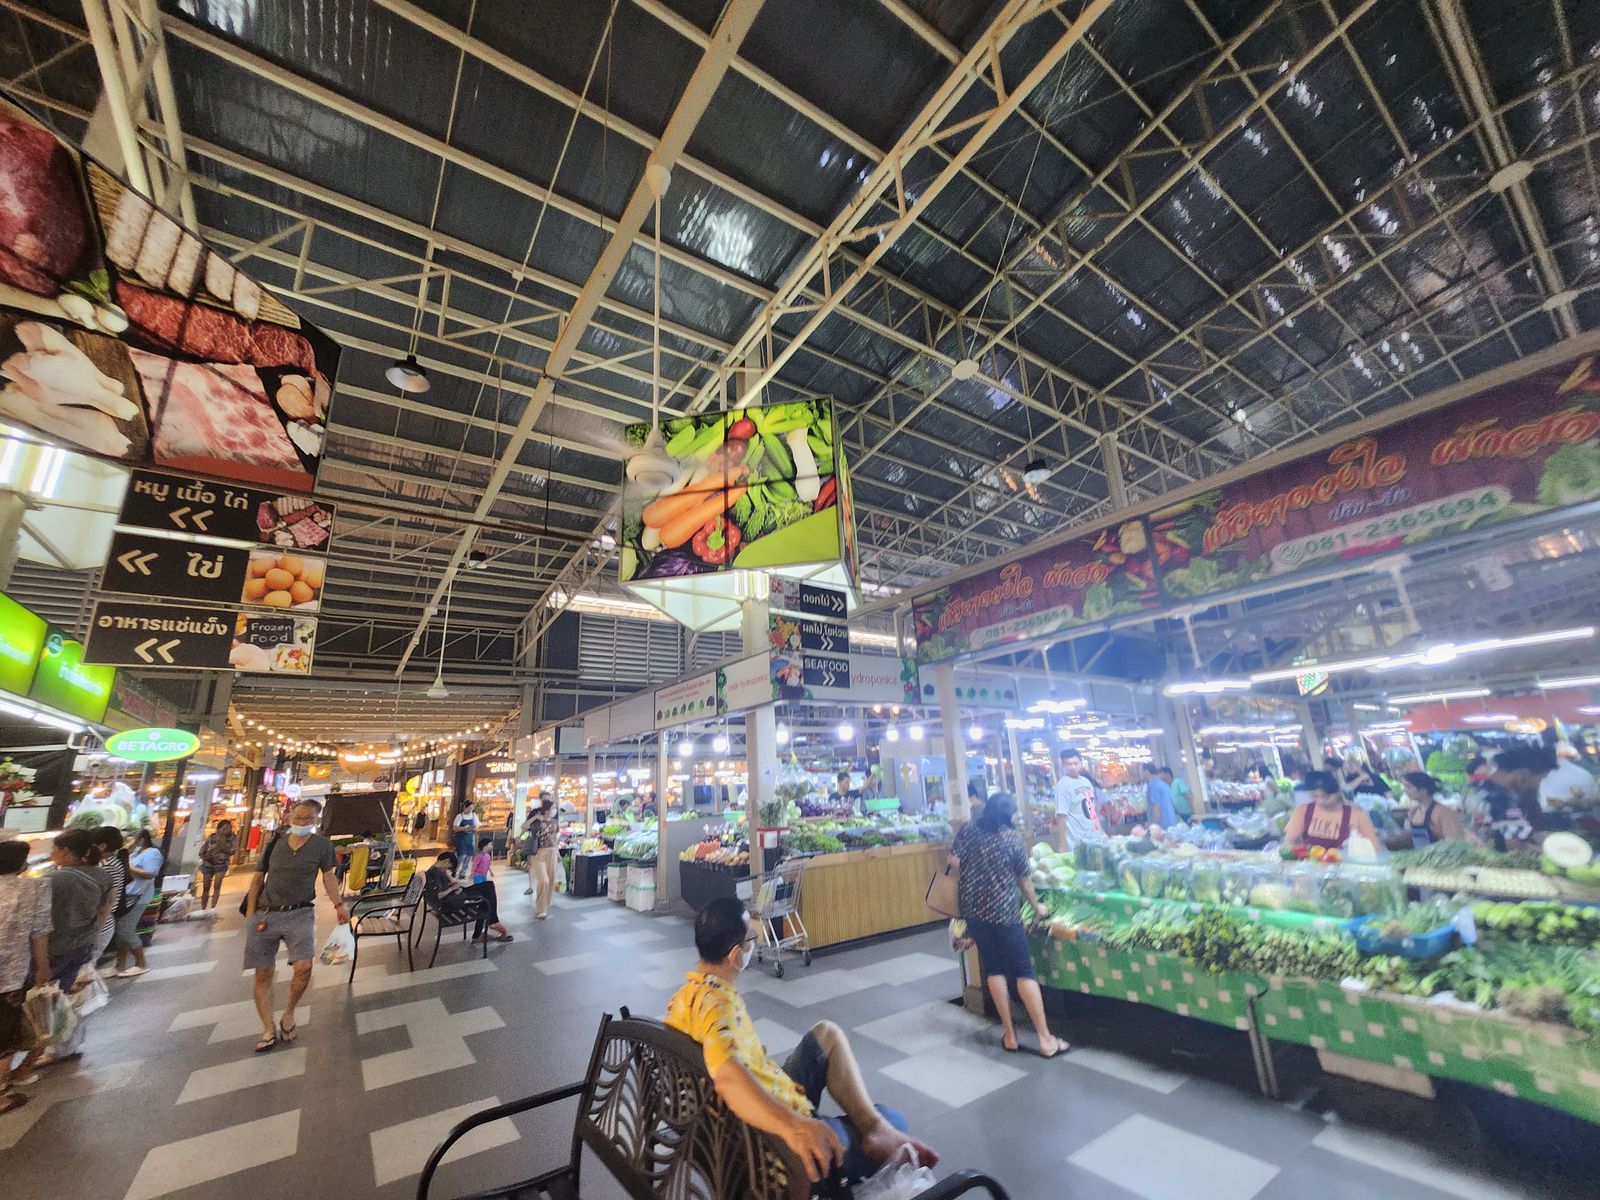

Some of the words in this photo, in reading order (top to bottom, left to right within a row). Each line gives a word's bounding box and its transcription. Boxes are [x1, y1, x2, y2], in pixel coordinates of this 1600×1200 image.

[134, 480, 169, 502] หมู
[176, 480, 216, 504] เนื้อ
[224, 491, 249, 510] ไก่
[186, 552, 224, 579] ไข่
[802, 593, 830, 607] ดอกไม้
[98, 615, 228, 636] อาหารแช่แข็ง
[251, 622, 292, 632] Frozen
[250, 633, 289, 643] Food
[804, 658, 848, 673] SEAFOOD
[851, 672, 897, 687] ydroponics
[117, 740, 189, 752] BETAGRO
